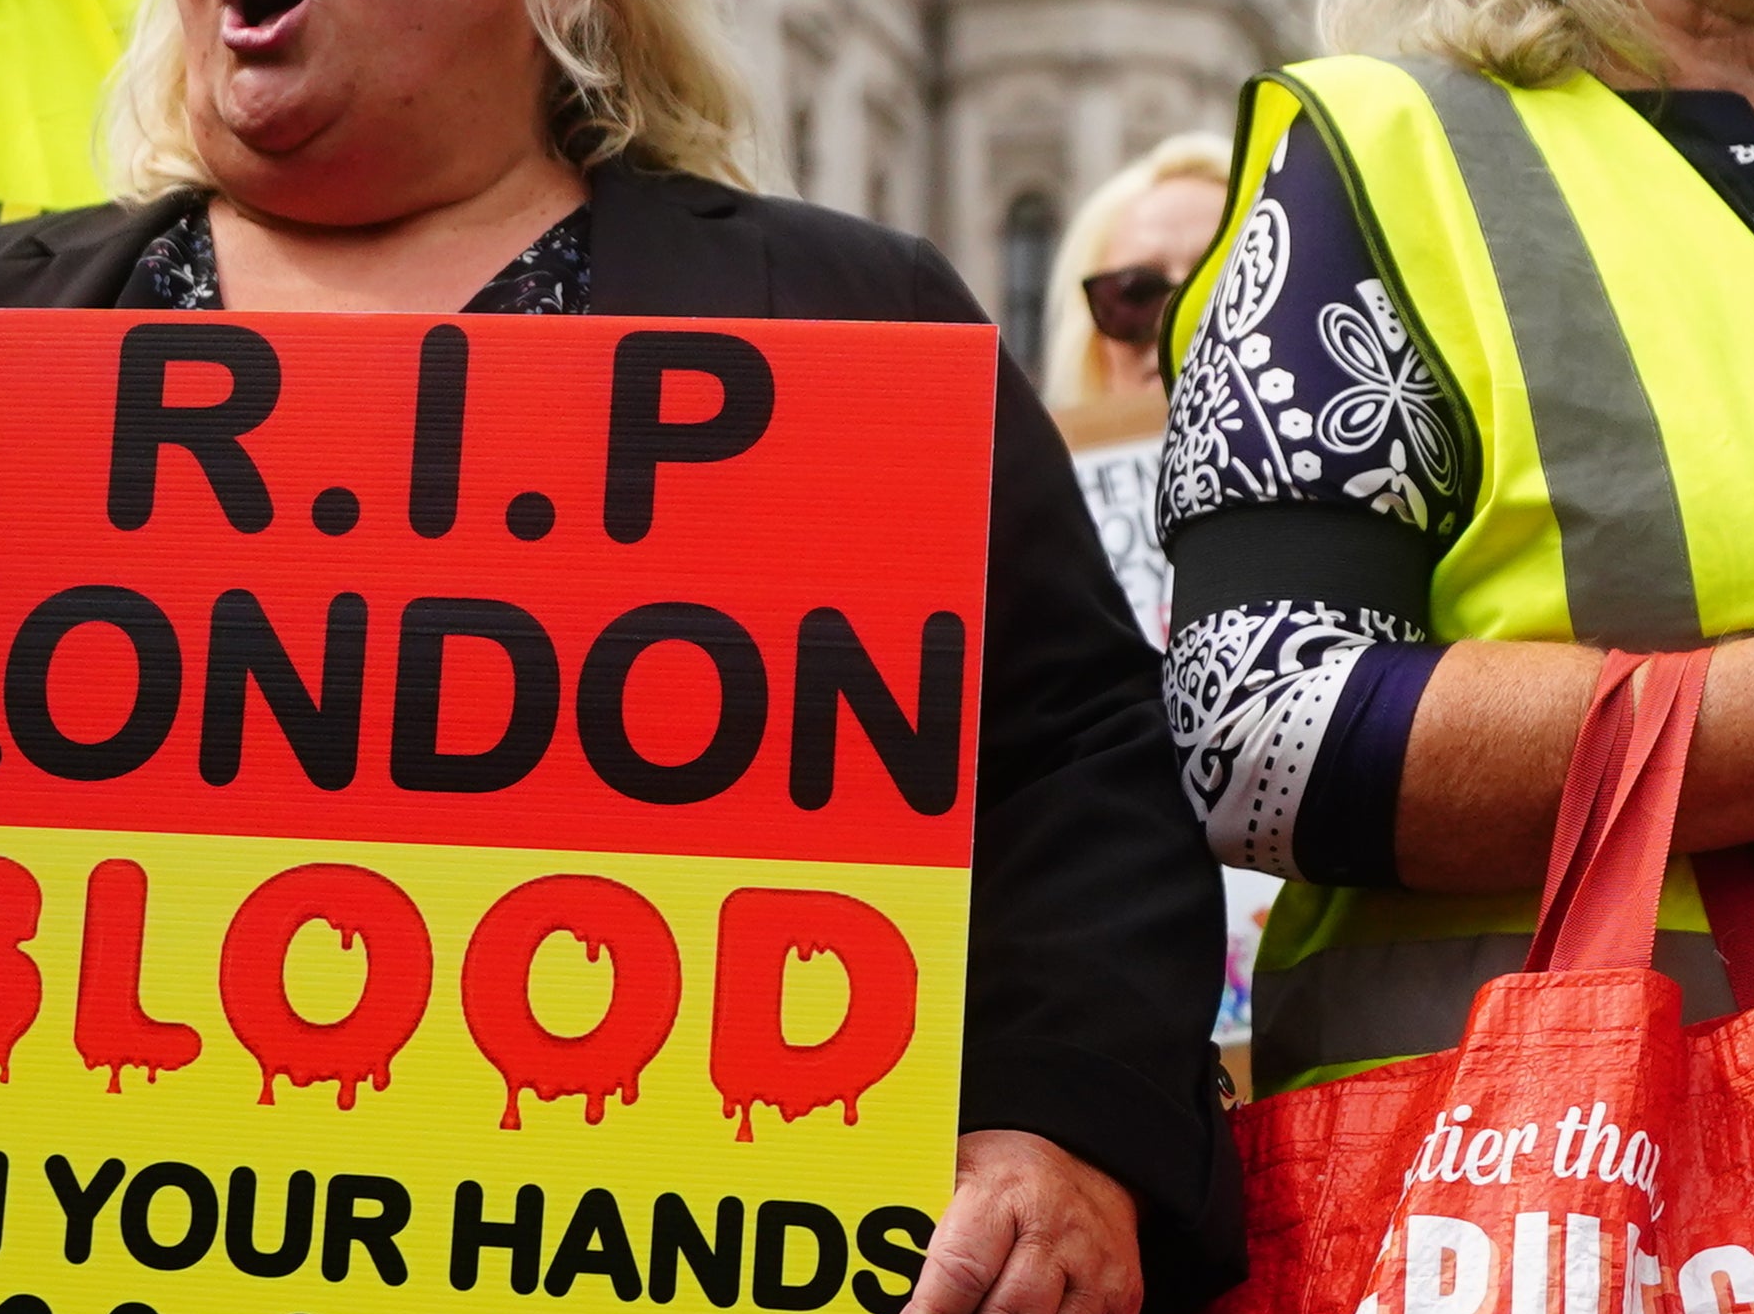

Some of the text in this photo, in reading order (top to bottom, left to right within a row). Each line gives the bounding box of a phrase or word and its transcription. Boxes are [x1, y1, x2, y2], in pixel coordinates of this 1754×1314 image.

[107, 323, 775, 543] R.I.P
[1403, 1100, 1664, 1195] tier tha
[44, 1154, 412, 1287] YOUR
